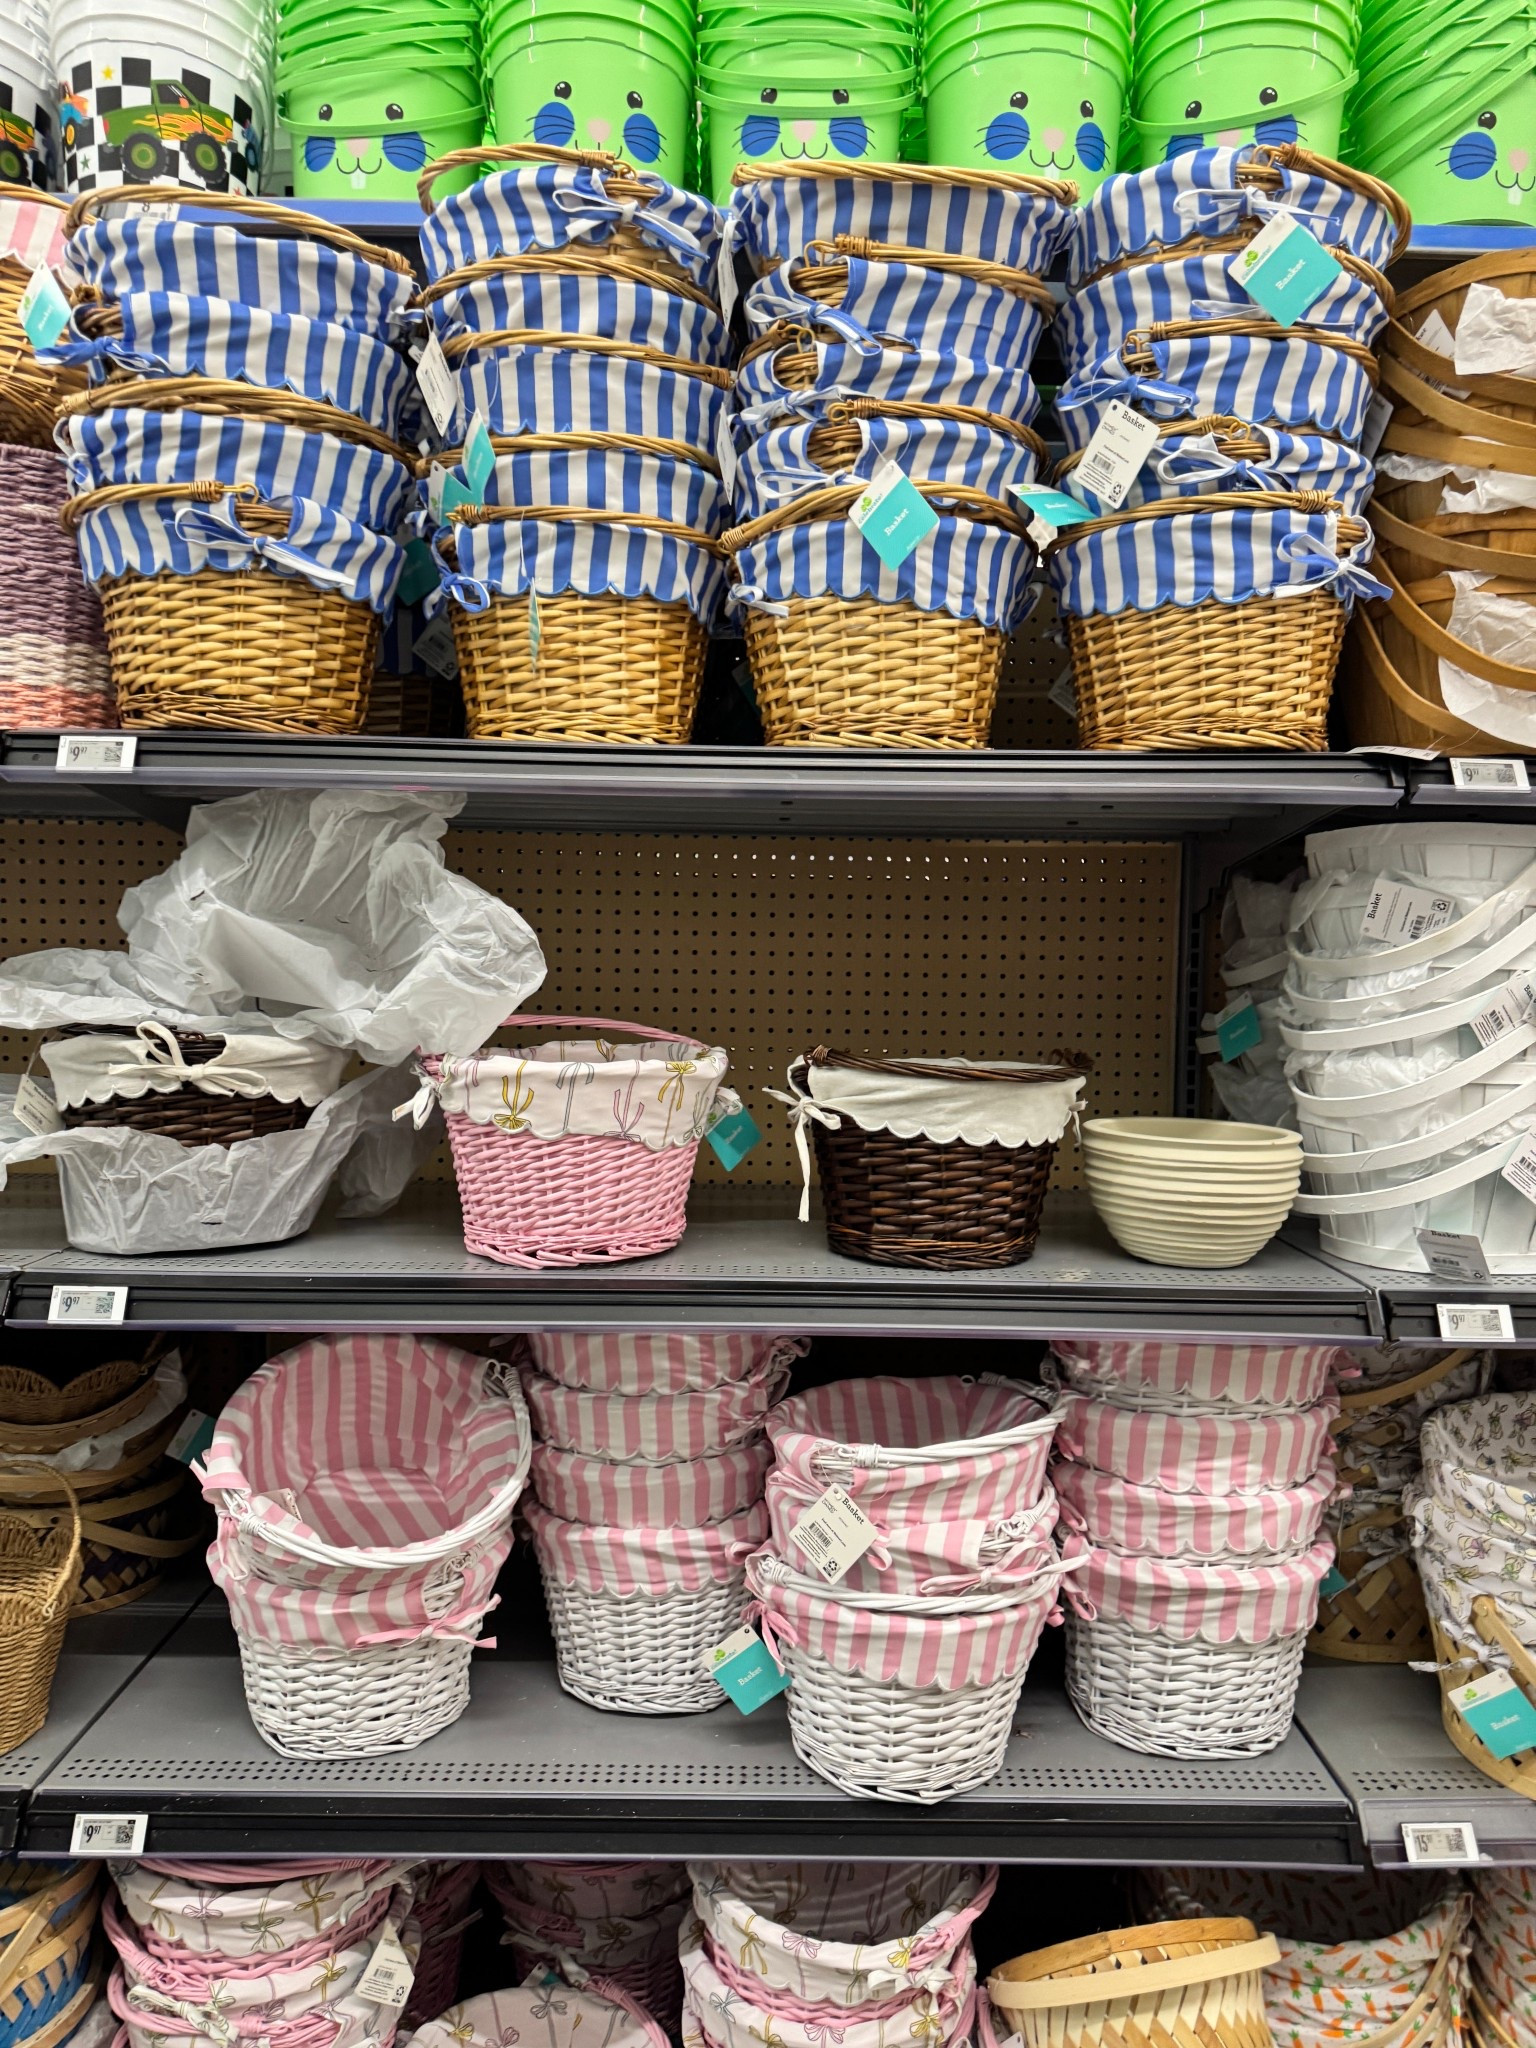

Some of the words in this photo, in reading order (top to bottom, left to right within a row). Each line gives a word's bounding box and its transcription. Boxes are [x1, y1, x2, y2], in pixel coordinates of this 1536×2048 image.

[1275, 259, 1306, 290] Basket
[1121, 410, 1146, 431] Basket
[884, 508, 909, 536] Basket
[1367, 893, 1382, 919] Basket
[1431, 1230, 1461, 1239] Basket
[842, 1497, 865, 1526] Basket
[737, 1667, 763, 1686] Basket
